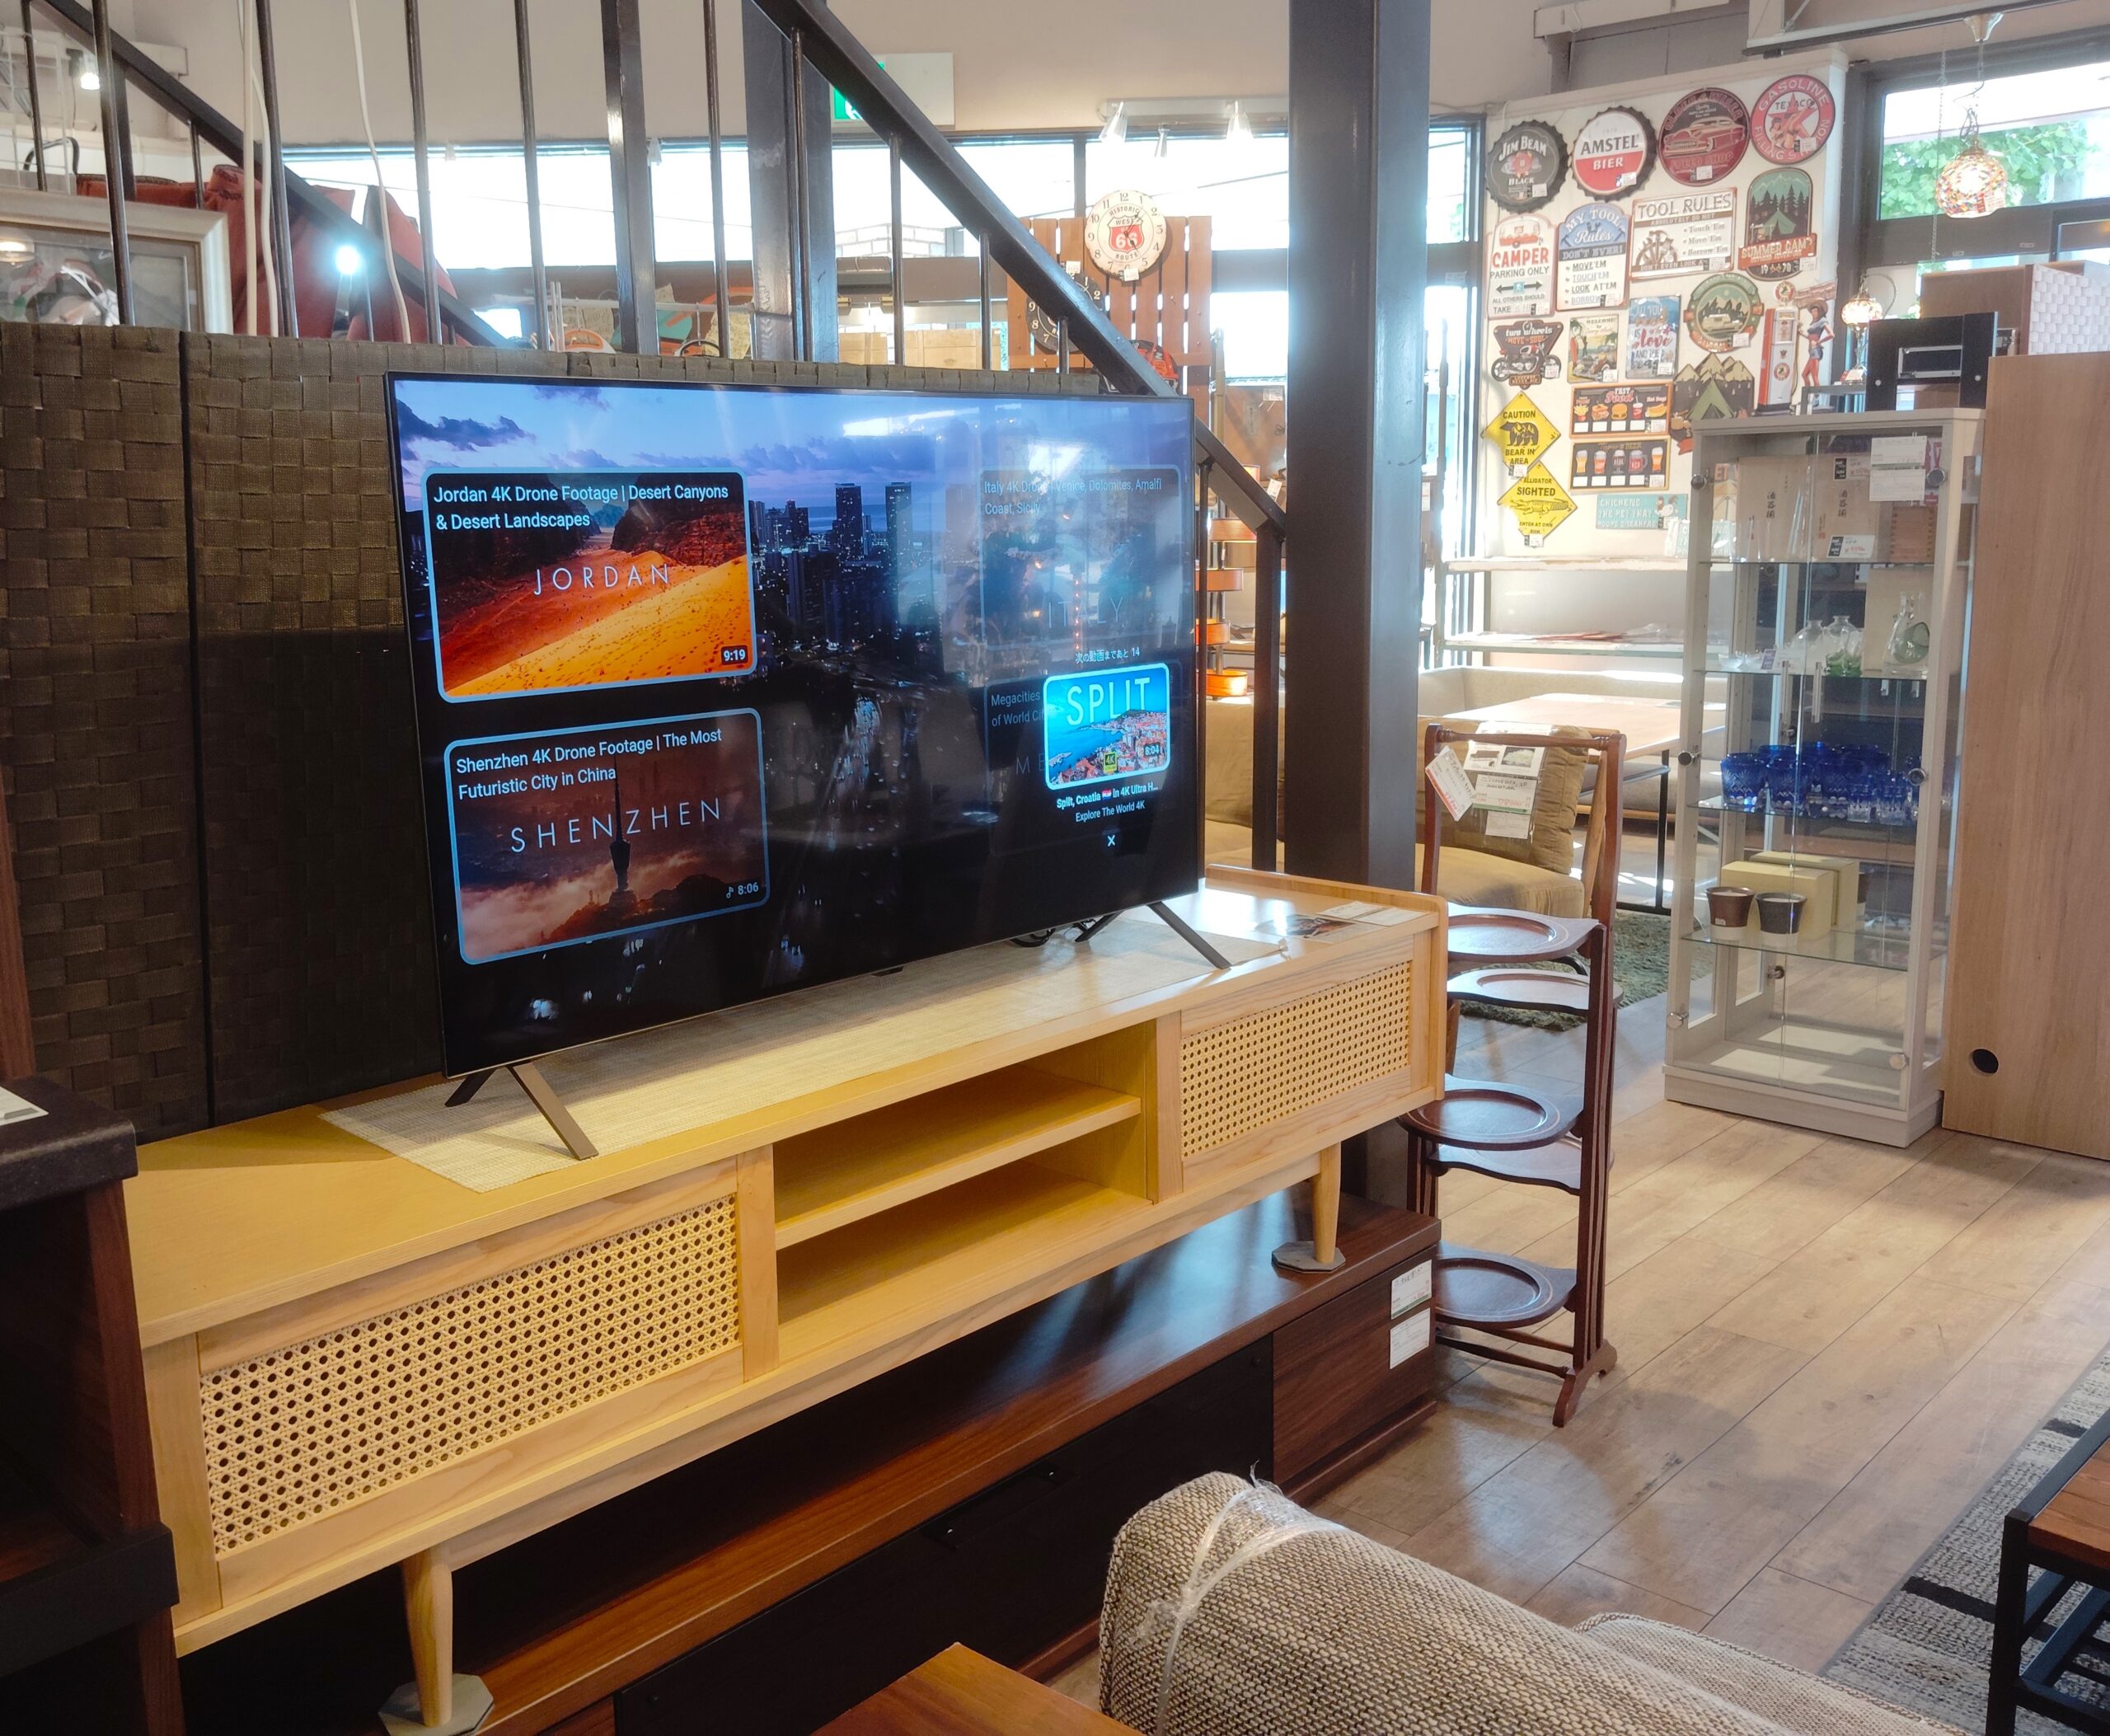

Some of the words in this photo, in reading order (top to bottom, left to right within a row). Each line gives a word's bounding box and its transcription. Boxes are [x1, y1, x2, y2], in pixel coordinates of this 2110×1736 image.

[1758, 78, 1830, 111] GASOLINE
[1498, 140, 1519, 162] JIM
[1521, 136, 1547, 157] BEAM
[1580, 134, 1639, 156] AMSTEL
[1753, 125, 1785, 160] FILLING
[1593, 157, 1624, 171] BIER
[1508, 177, 1535, 185] BLACK
[1102, 199, 1109, 209] 11
[1119, 192, 1129, 202] 12
[1139, 195, 1143, 204] 1
[1109, 205, 1140, 216] HISTORIC
[1151, 207, 1158, 216] 2
[1637, 200, 1679, 220] TOOL
[1682, 193, 1732, 214] RULES
[1090, 213, 1100, 223] 10
[1566, 213, 1585, 232] MY
[1156, 224, 1164, 234] 3
[1087, 232, 1095, 242] 9
[1574, 229, 1613, 244] Rules
[1152, 242, 1160, 251] 4
[1742, 242, 1782, 259] SUMMER
[1095, 249, 1101, 259] 8
[1115, 252, 1138, 260] ROUTE
[1493, 247, 1549, 269] CAMPER
[1142, 257, 1148, 266] 5
[1490, 267, 1526, 279] PARKING
[1527, 265, 1550, 276] ONLY
[1761, 264, 1769, 274] 19
[1571, 284, 1590, 294] LOOK
[1503, 410, 1536, 419] CAUTION
[1505, 448, 1525, 457] BEAR
[1527, 448, 1535, 456] IN
[984, 481, 1004, 496] Italy
[1006, 481, 1020, 493] 4K
[1135, 478, 1161, 491] Amalfi
[1522, 476, 1552, 485] ALLIGATOR
[434, 486, 488, 504] Jordan
[490, 486, 512, 504] 4K
[514, 486, 559, 503] Drone
[561, 484, 619, 505] Footage
[628, 484, 672, 502] Desert
[673, 483, 729, 503] Canyons
[1517, 486, 1556, 496] SIGHTED
[985, 502, 1015, 516] Coast,
[1017, 502, 1041, 516] Sicily
[436, 513, 448, 531] &
[451, 512, 501, 531] Desert
[504, 511, 591, 531] Landscapes
[532, 562, 671, 596] JORDAN
[723, 647, 747, 664] 9:19
[1131, 646, 1141, 657] 14
[991, 690, 1042, 708] Megacities
[1066, 676, 1151, 727] SPLIT
[992, 713, 1002, 727] of
[1004, 711, 1030, 726] World
[457, 752, 529, 774] Shenzhen
[532, 747, 552, 766] 4K
[555, 743, 596, 762] Drone
[598, 736, 654, 758] Footage
[663, 732, 687, 749] The
[690, 728, 723, 746] Most
[458, 777, 528, 801] Futuristic
[531, 774, 559, 795] City
[561, 772, 574, 787] in
[577, 766, 617, 785] China
[1057, 797, 1075, 810] Split,
[1076, 791, 1101, 805] Croatia
[1120, 786, 1130, 796] 4K
[1131, 784, 1146, 795] Ultra
[1076, 810, 1101, 823] Explore
[1102, 806, 1115, 817] The
[1116, 803, 1136, 814] World
[1136, 800, 1146, 810] 4K
[509, 797, 723, 854] SHENZHEN
[738, 881, 760, 898] 8:06
